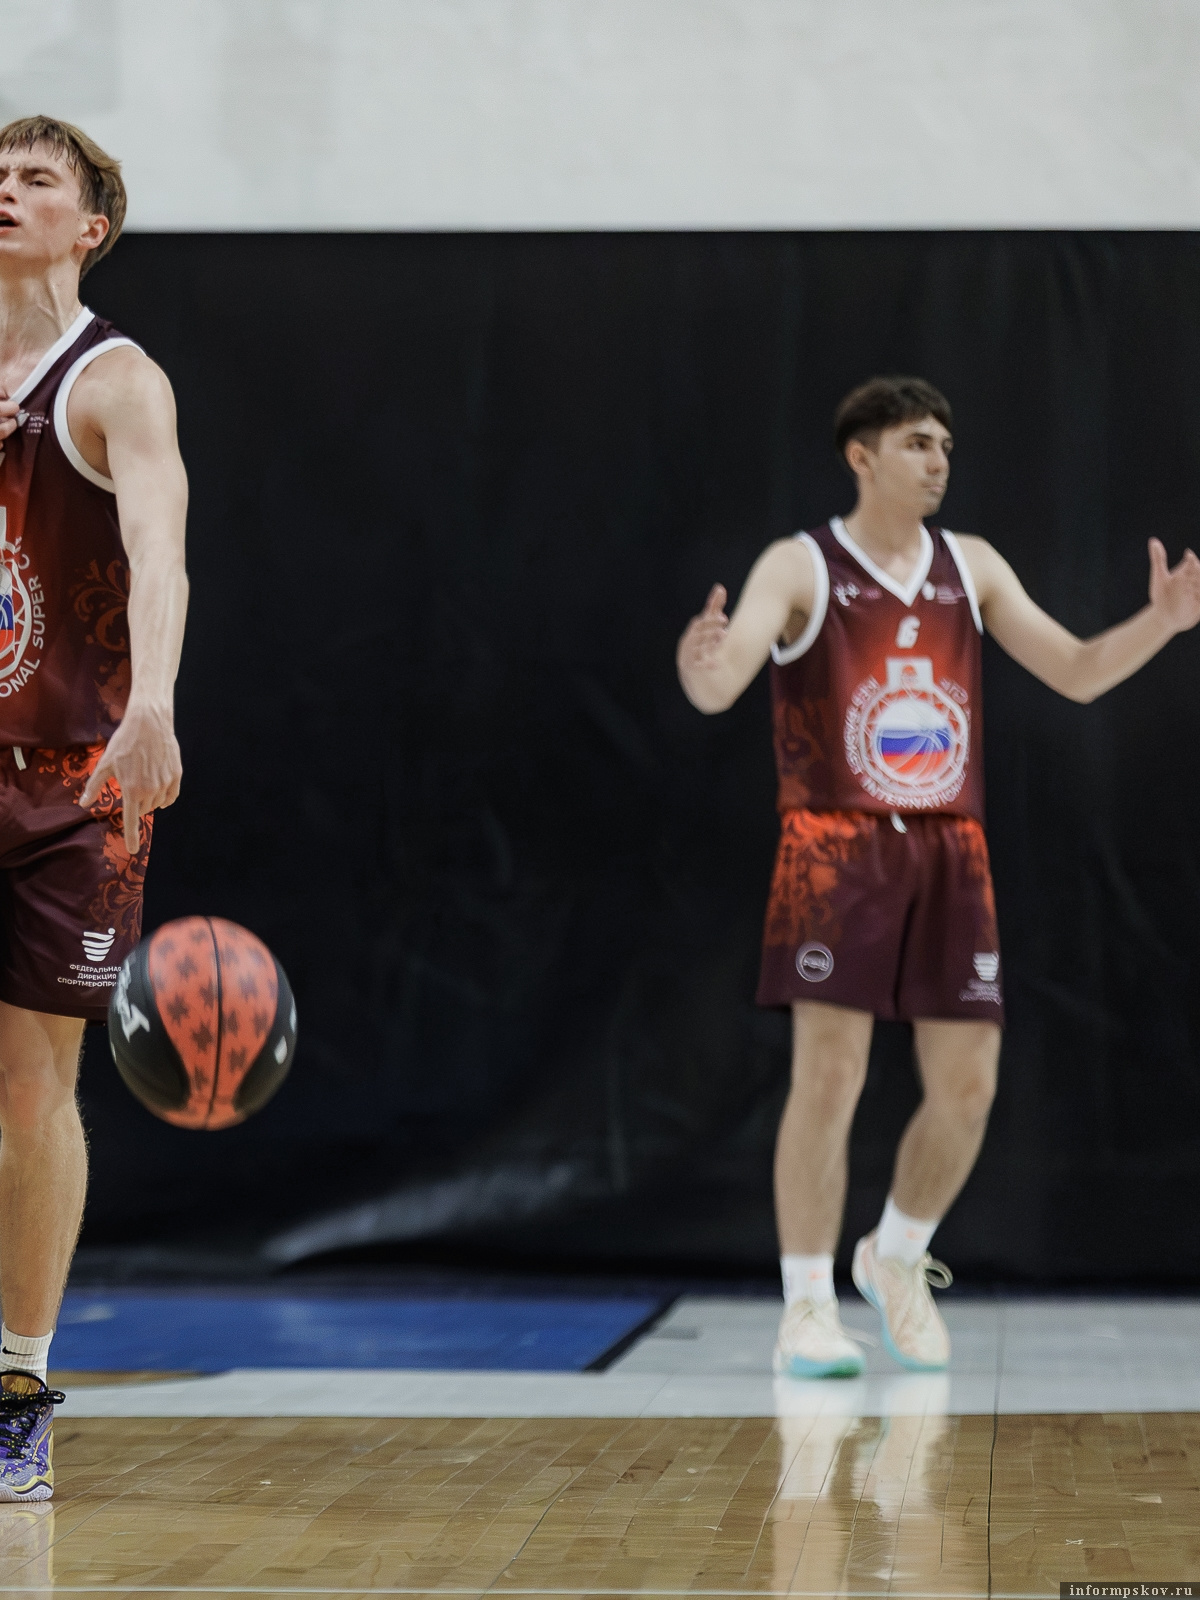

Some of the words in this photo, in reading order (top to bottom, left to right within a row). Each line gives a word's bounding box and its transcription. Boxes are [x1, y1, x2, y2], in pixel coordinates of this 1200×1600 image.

[28, 575, 46, 650] SUPER
[77, 972, 117, 981] ДИРЕКЦИЯ
[57, 977, 117, 987] СПОРТМЕРОПРИ
